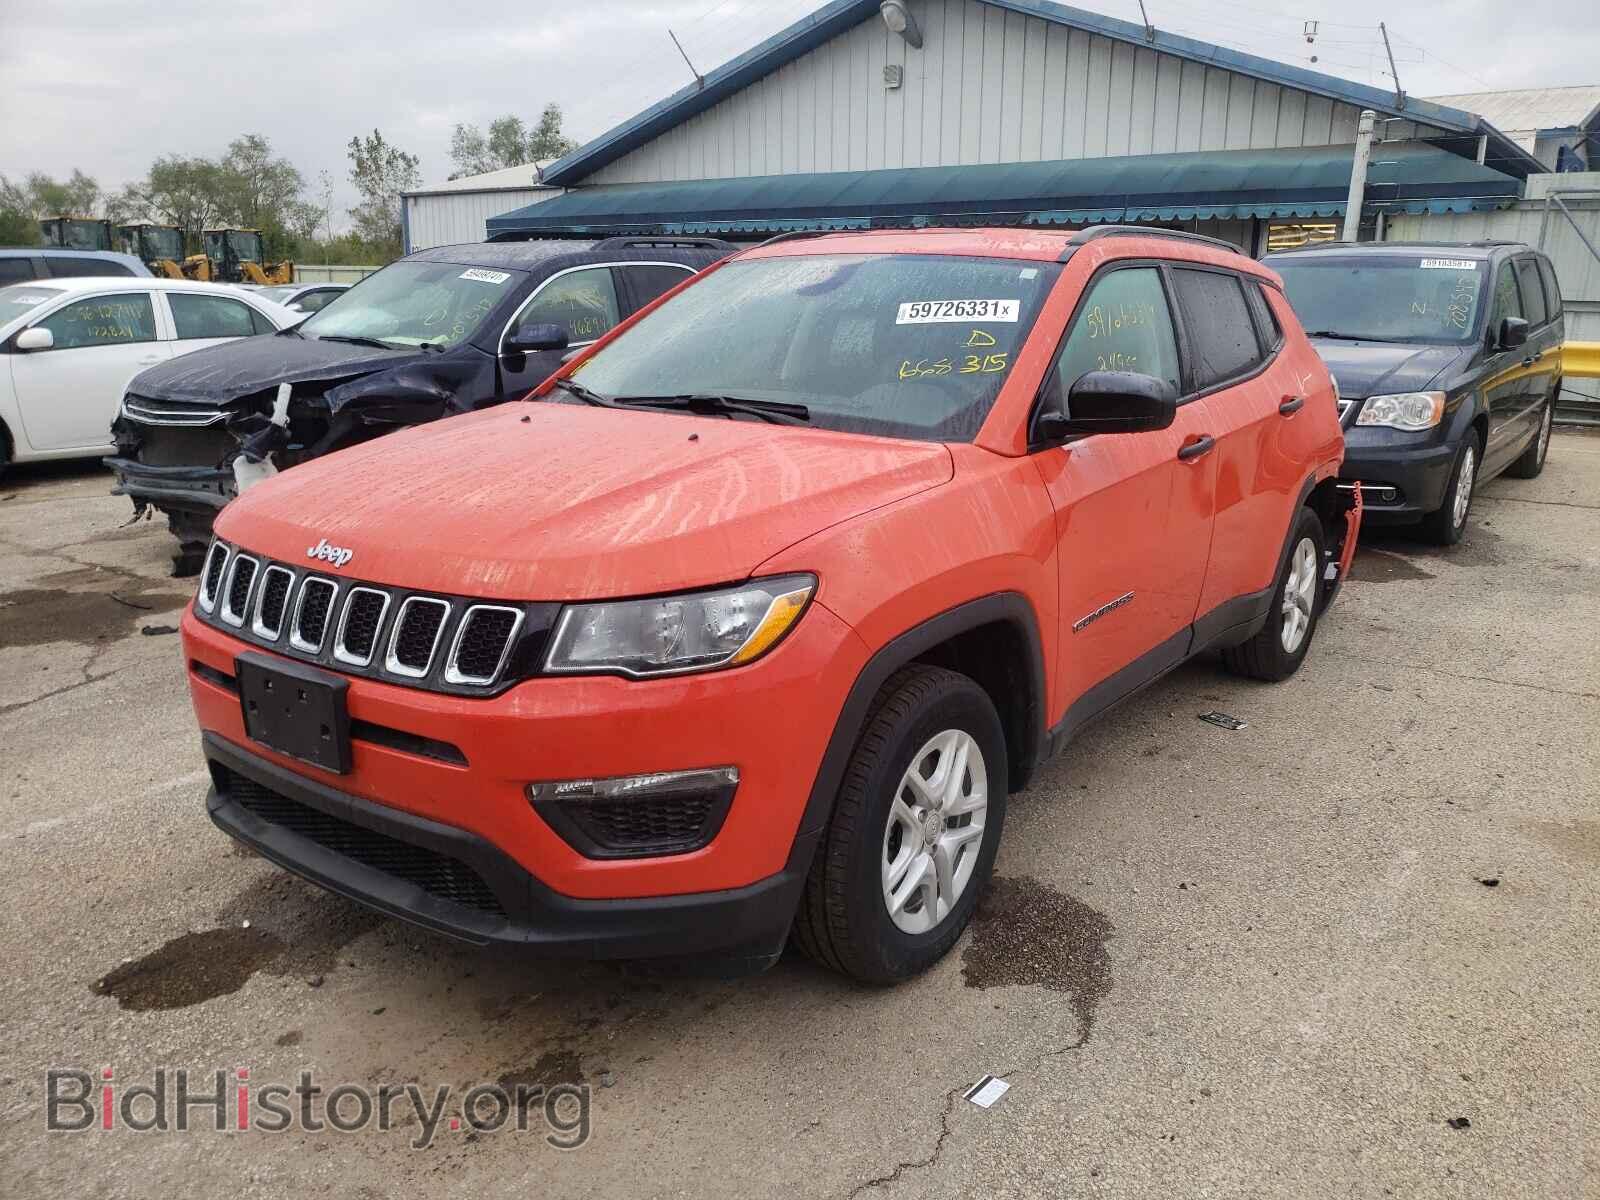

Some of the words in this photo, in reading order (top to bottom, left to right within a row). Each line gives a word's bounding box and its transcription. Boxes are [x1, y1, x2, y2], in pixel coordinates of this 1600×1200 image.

[967, 329, 996, 347] D
[960, 352, 1008, 373] 315
[306, 538, 353, 568] Jeep
